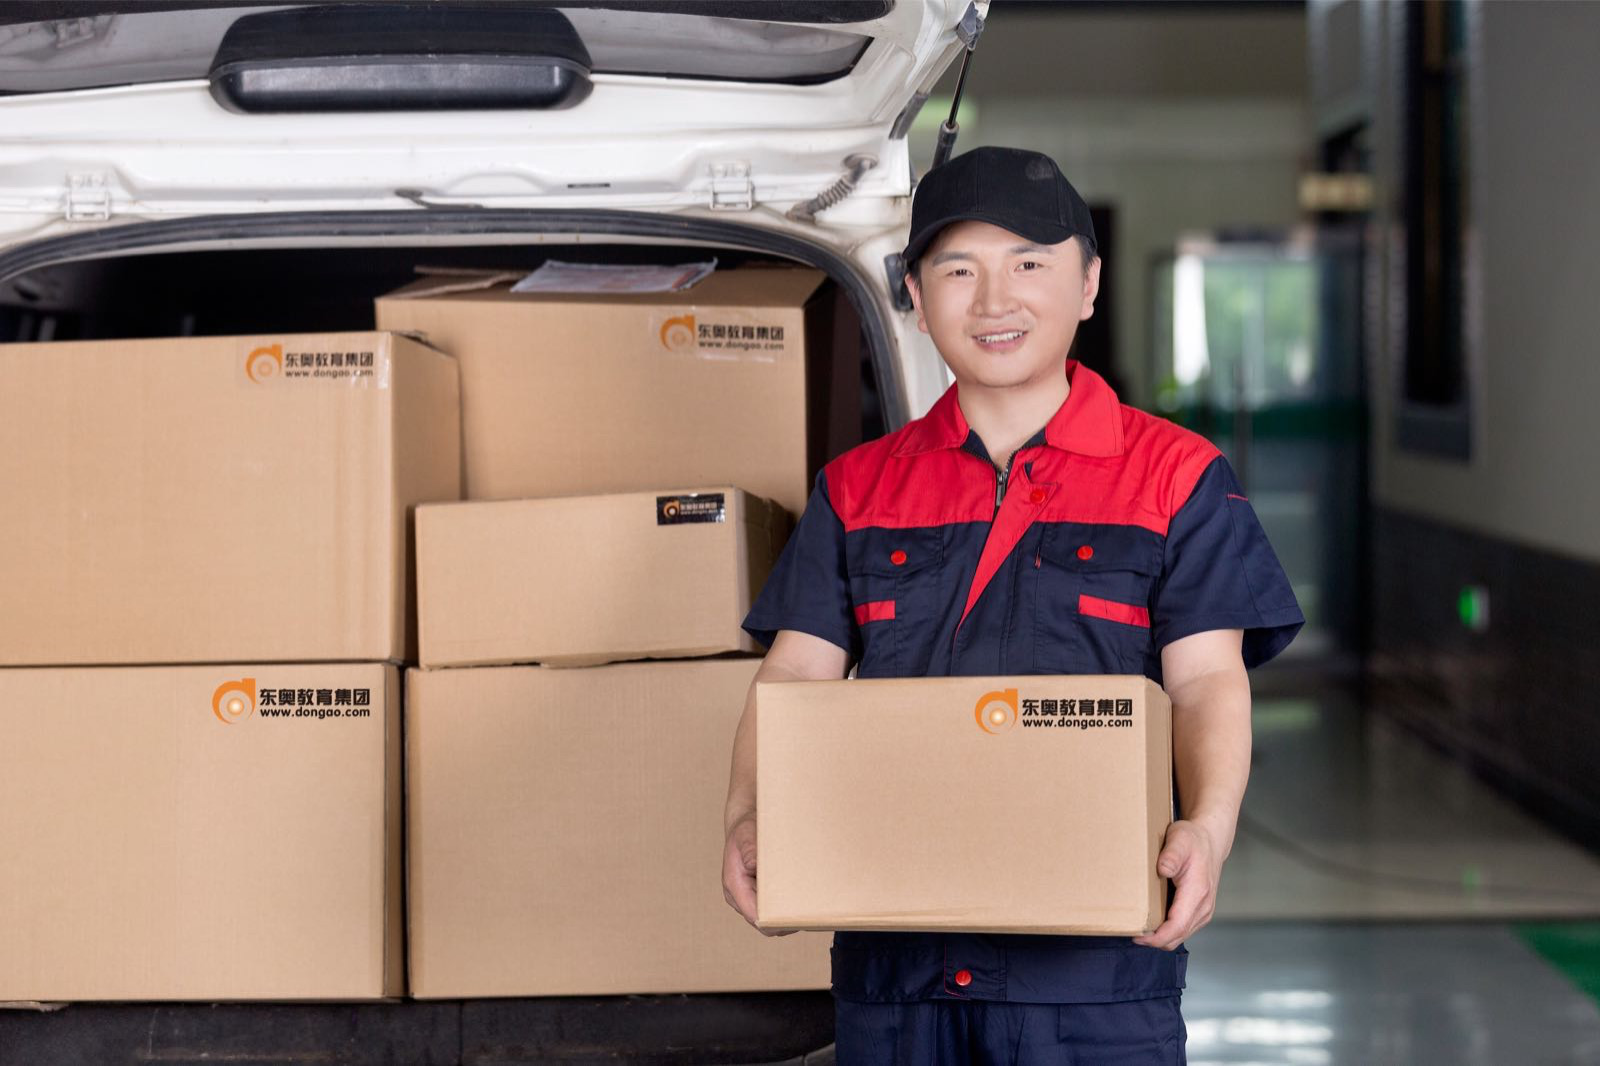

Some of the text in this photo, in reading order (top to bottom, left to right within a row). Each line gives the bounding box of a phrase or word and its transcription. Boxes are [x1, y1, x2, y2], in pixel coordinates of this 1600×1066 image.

[285, 352, 374, 367] 东奥教育集团
[259, 688, 370, 706] 东奥教育集团
[260, 706, 370, 719] www.dongao.com
[1022, 699, 1133, 716] 东奥教育集团
[1022, 717, 1133, 730] www.dongao.com
